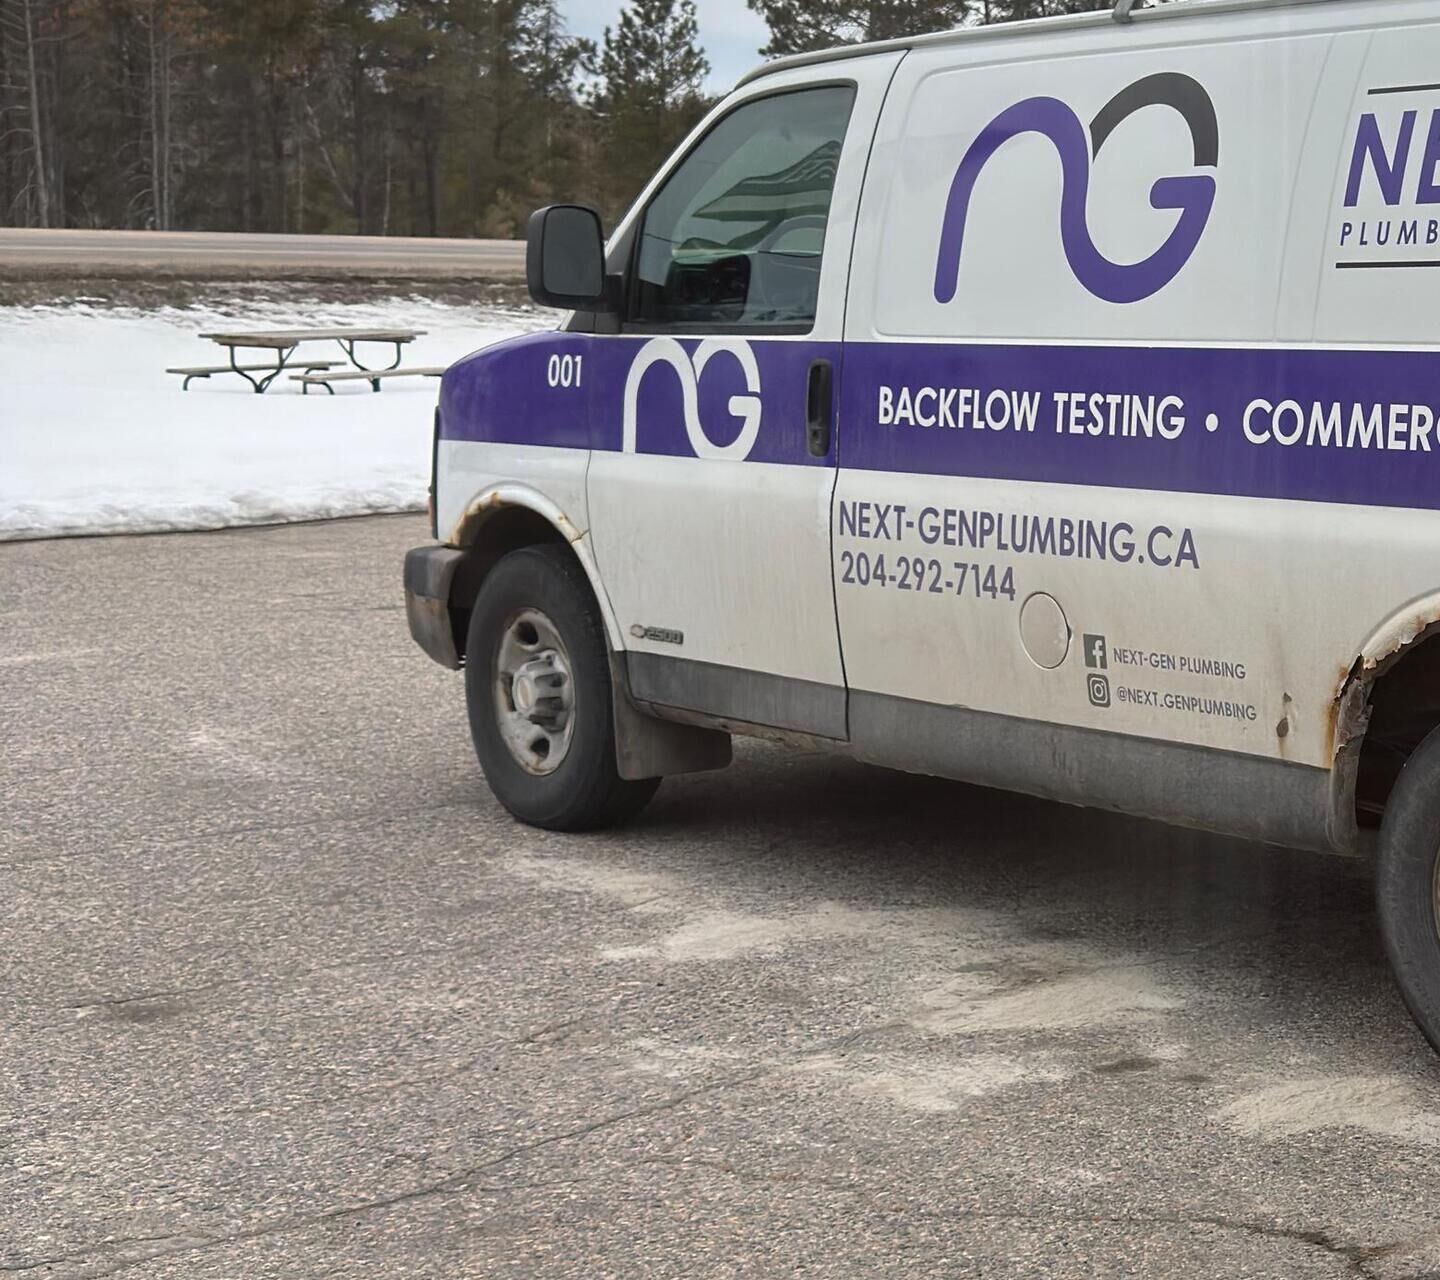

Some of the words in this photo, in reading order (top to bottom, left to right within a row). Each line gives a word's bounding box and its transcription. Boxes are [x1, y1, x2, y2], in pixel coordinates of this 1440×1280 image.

[547, 353, 583, 388] 001
[878, 385, 1041, 432] BACKFLOW
[1053, 391, 1186, 440] TESTING
[839, 500, 1201, 570] NEXT-GENPLUMBING.CA
[841, 550, 1016, 602] 204-292-7144
[1113, 647, 1176, 671] NEXT-GEN
[1179, 657, 1247, 680] PLUMBING
